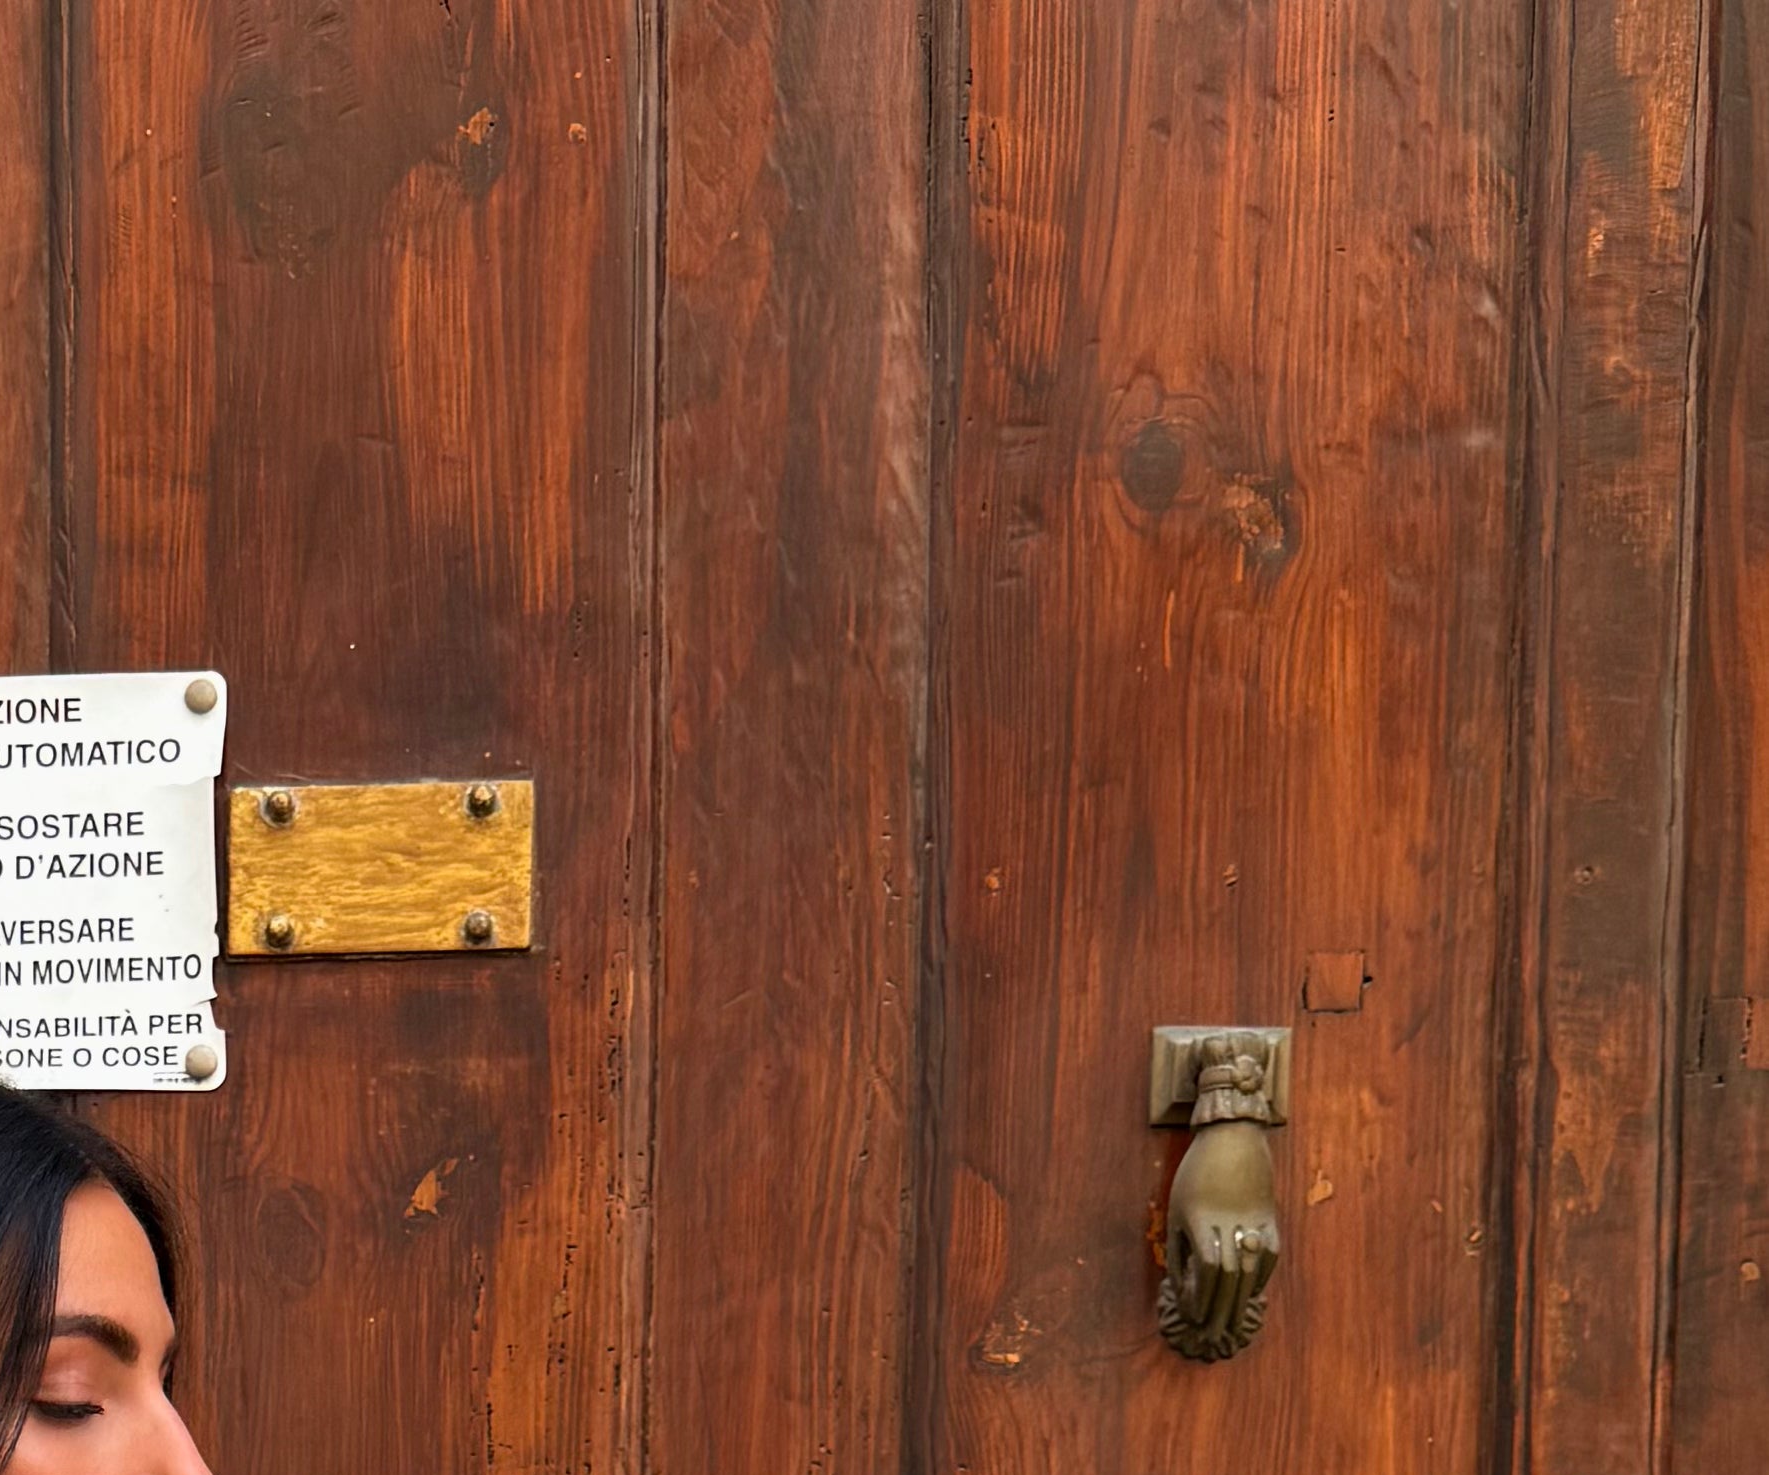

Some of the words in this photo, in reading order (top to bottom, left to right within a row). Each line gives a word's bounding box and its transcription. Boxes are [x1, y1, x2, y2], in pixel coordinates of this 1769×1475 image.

[15, 851, 164, 880] D'AZIONE
[32, 953, 202, 985] MOVIMENTO
[148, 1013, 203, 1035] PER
[72, 1046, 92, 1068] O
[102, 1045, 179, 1068] COSE
